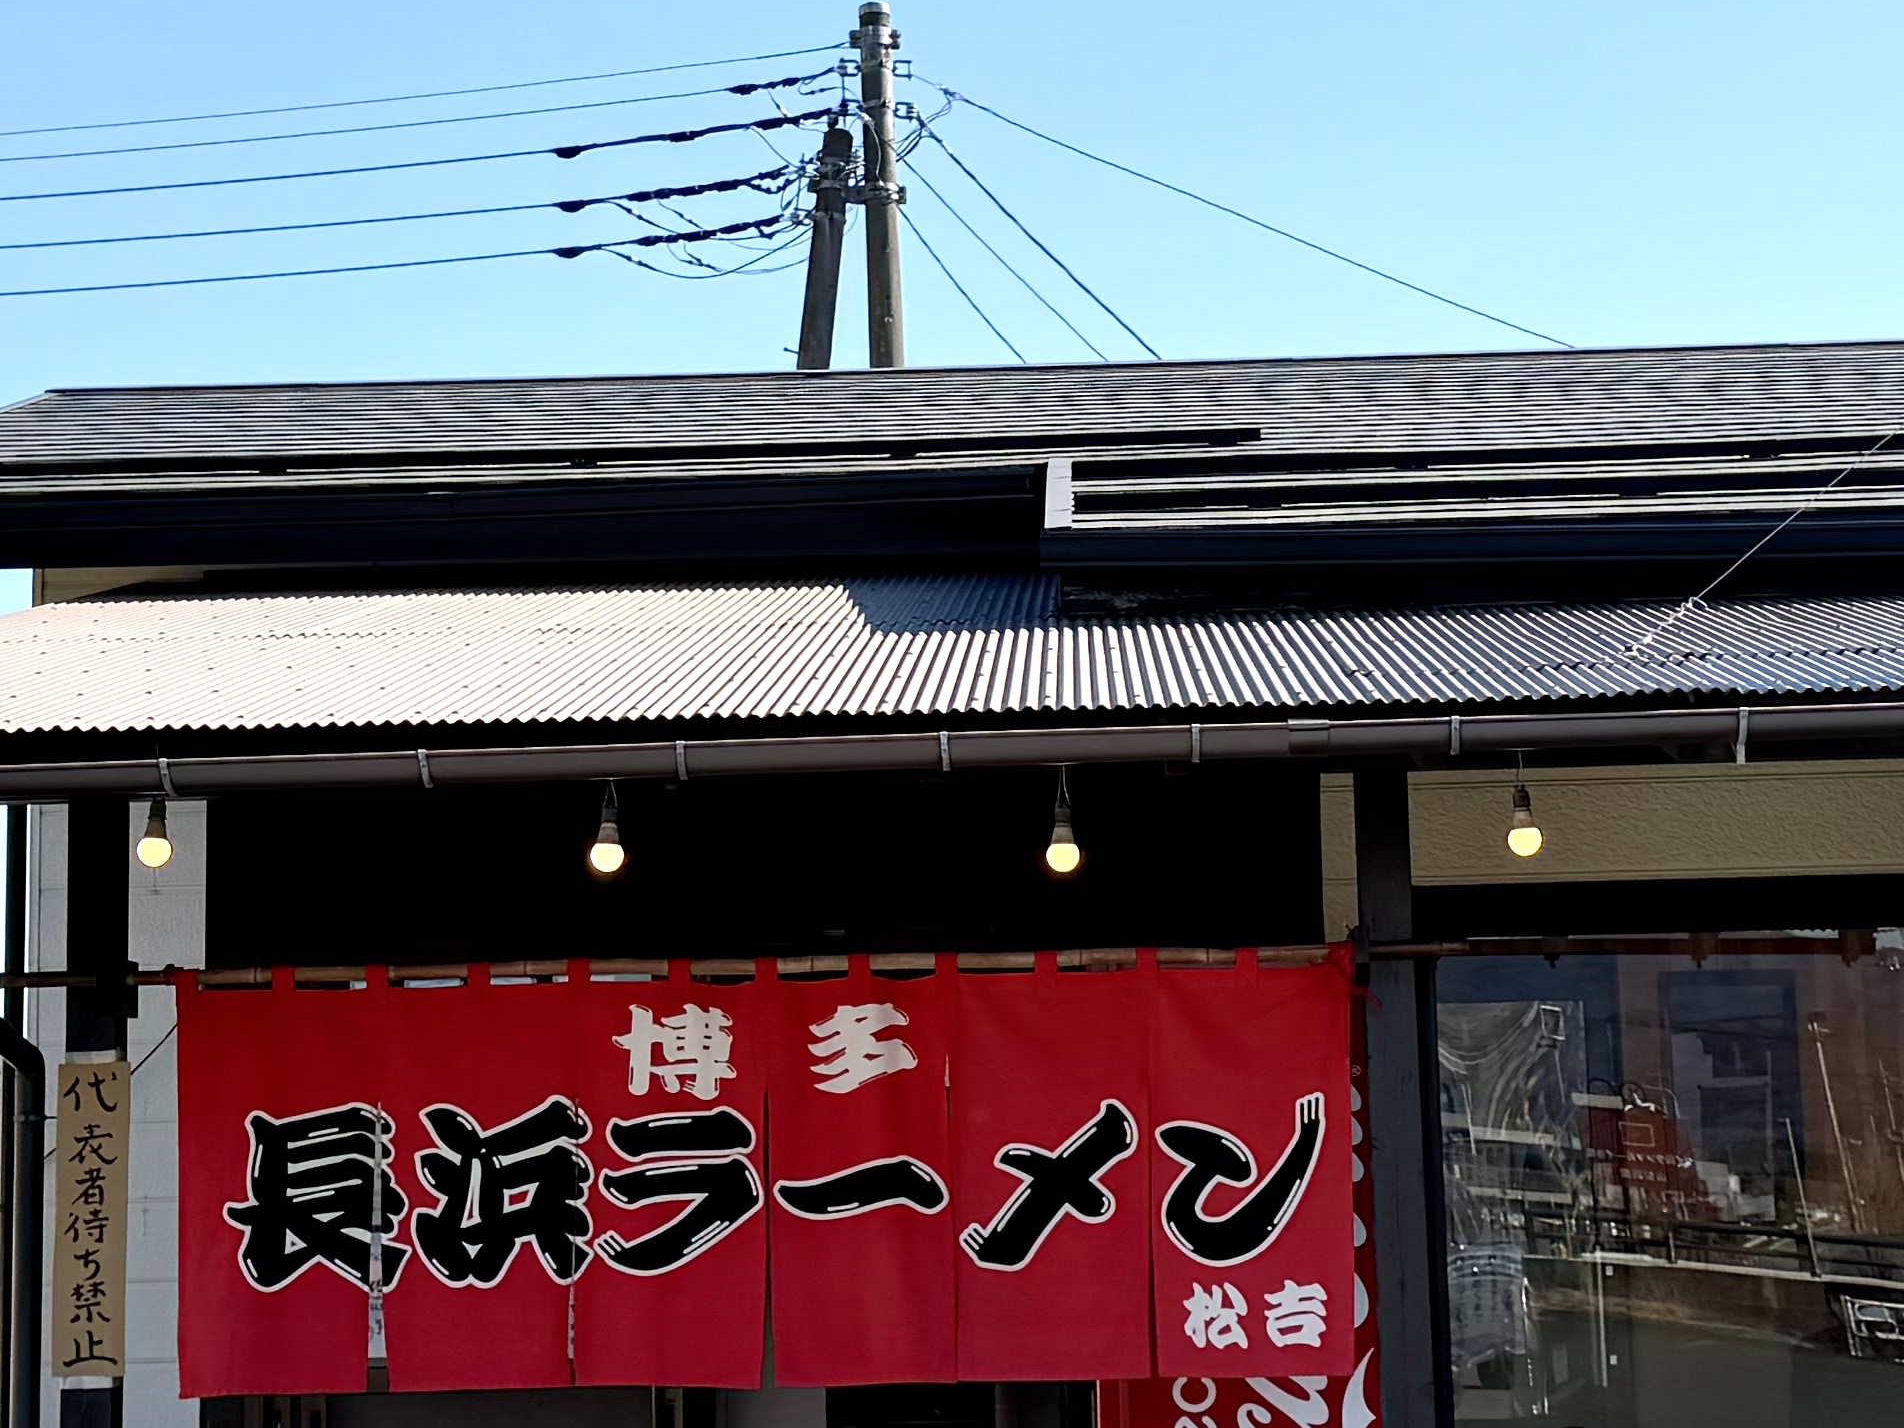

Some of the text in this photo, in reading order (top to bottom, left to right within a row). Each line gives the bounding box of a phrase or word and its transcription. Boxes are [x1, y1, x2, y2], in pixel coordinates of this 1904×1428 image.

[612, 1002, 920, 1100] 博多
[62, 1071, 119, 1368] 代表者待ち禁止
[223, 1090, 1327, 1294] 長浜ラーメン
[1182, 1279, 1328, 1350] 松吉
